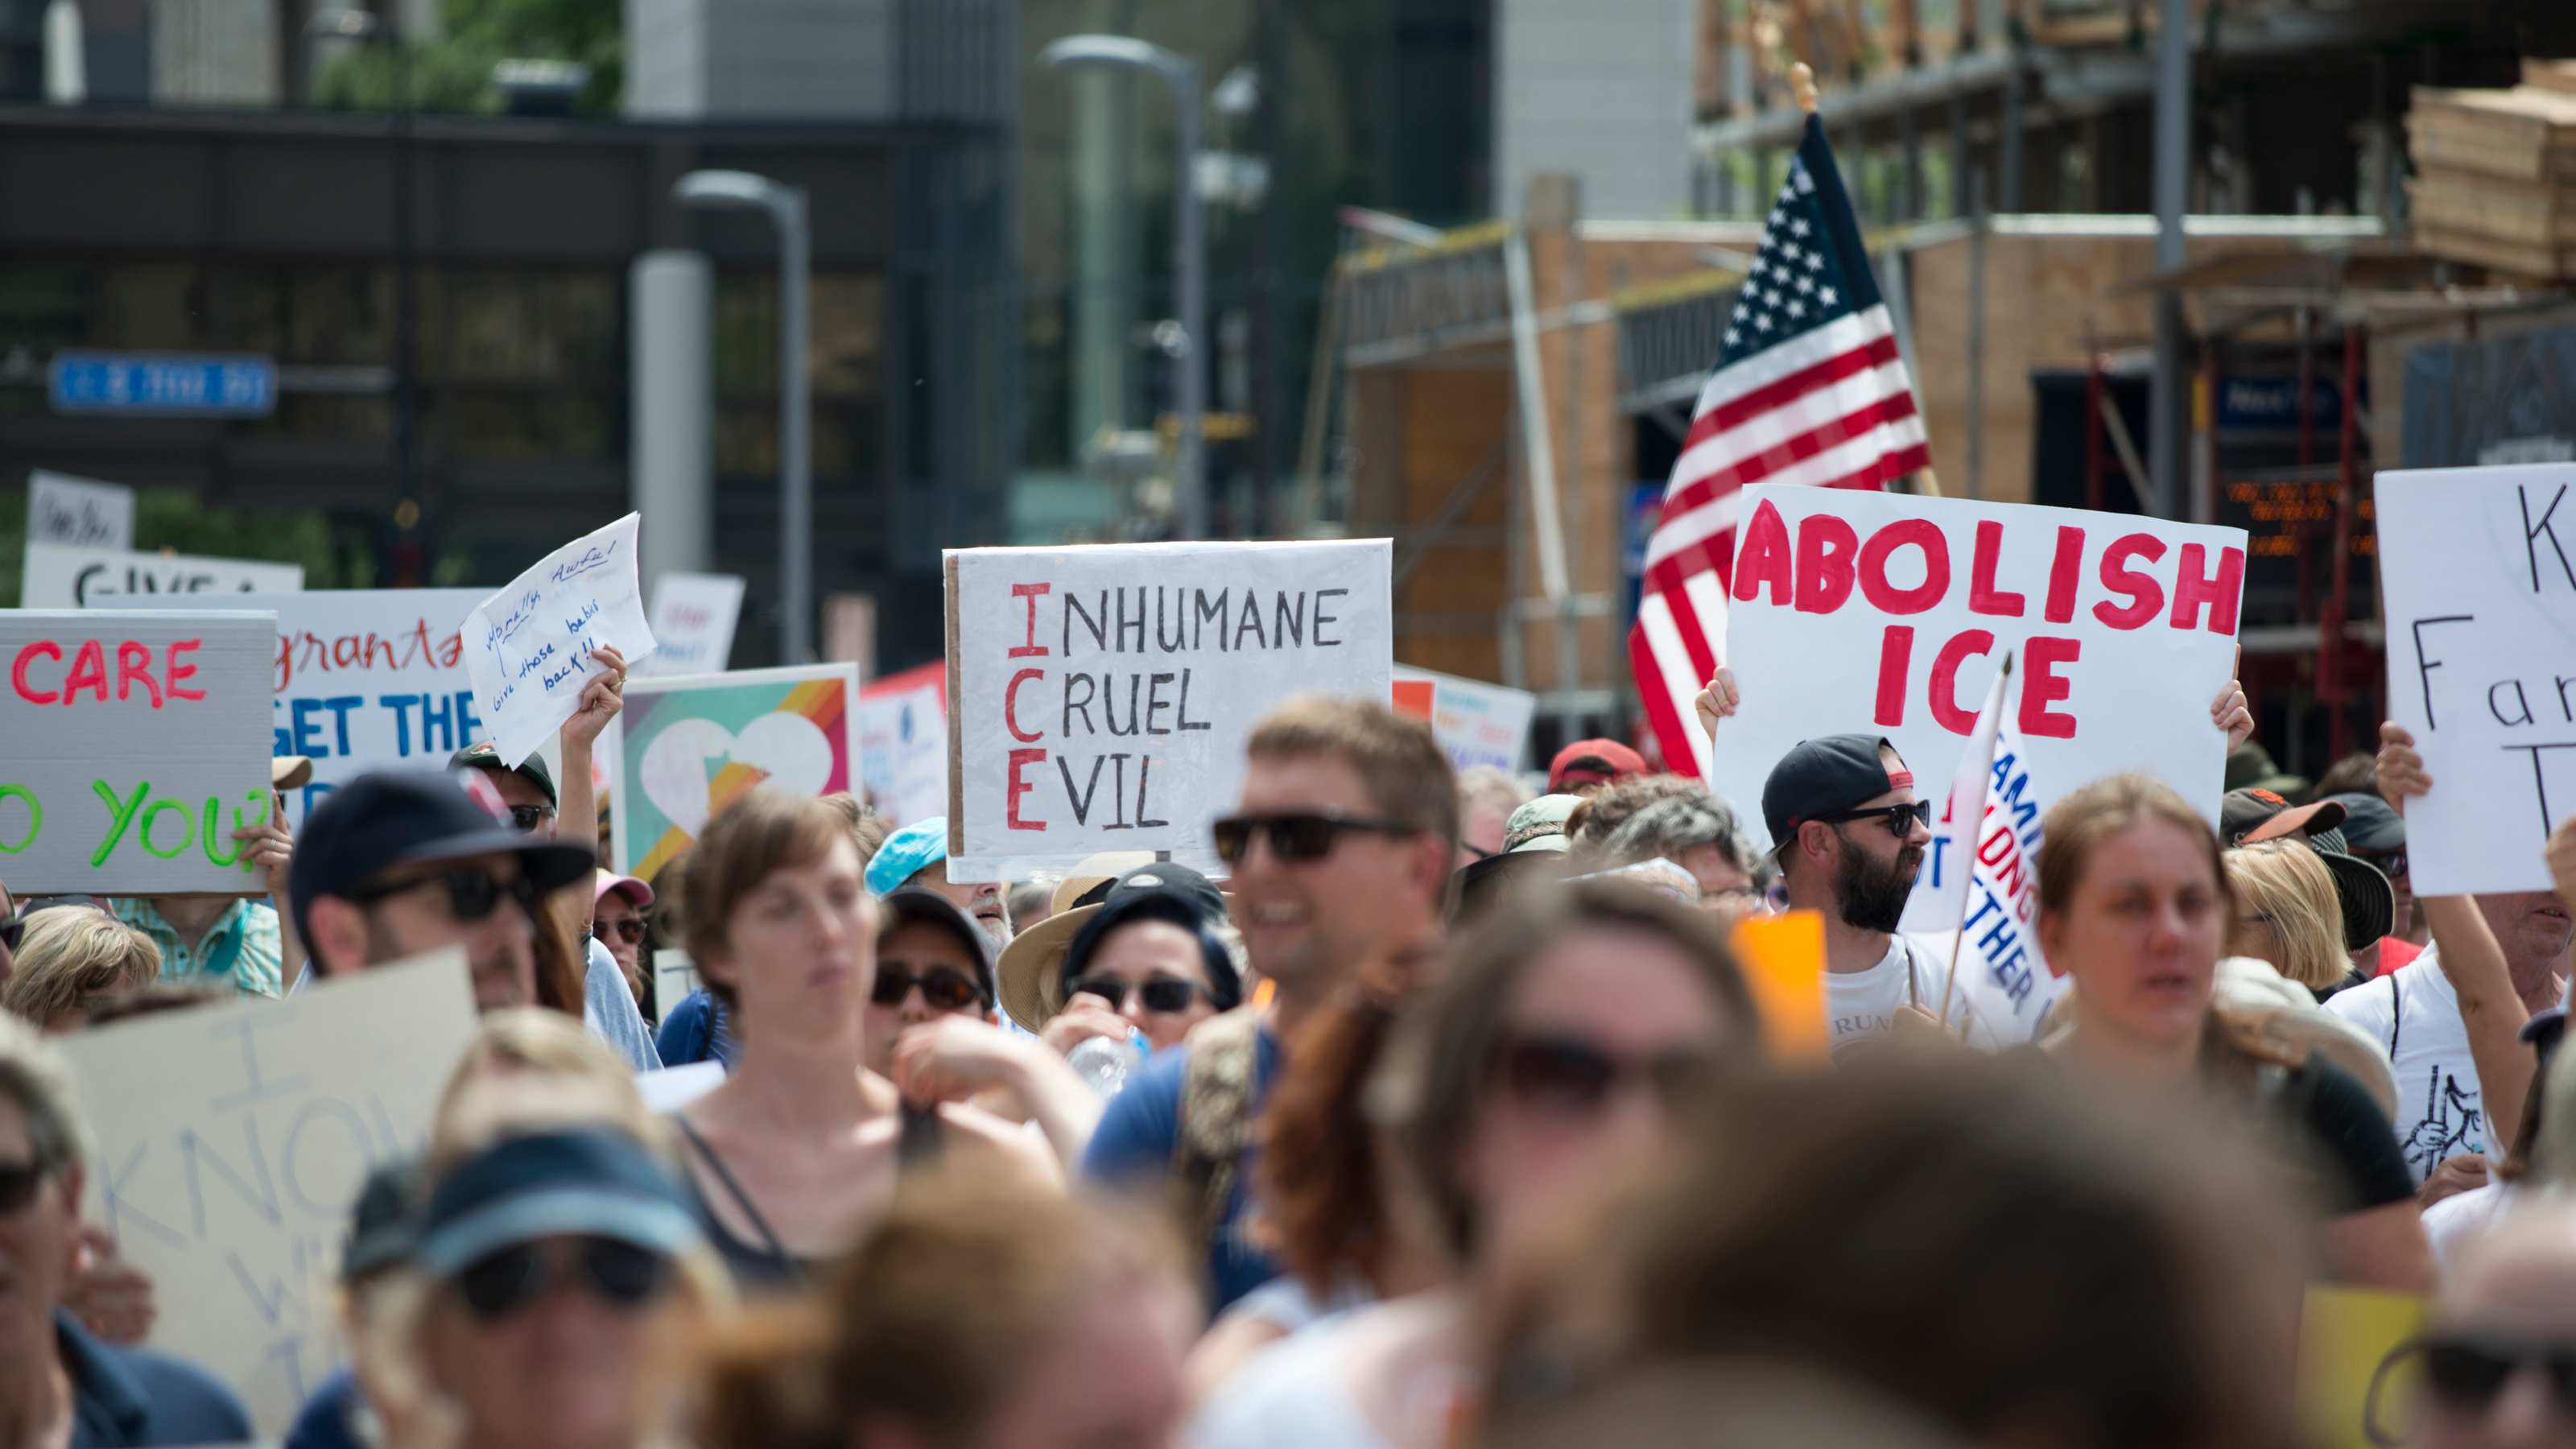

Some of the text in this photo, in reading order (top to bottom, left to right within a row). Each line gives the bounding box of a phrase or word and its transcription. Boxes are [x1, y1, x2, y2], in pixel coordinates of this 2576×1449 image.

[1732, 497, 2244, 636] ABOLISH
[1008, 582, 1348, 658] INHUMANE
[11, 638, 208, 710] CARE
[519, 642, 555, 679] those
[1874, 625, 2082, 739] ICE
[1005, 668, 1212, 742] CRUEL
[1007, 748, 1169, 831] EVIL
